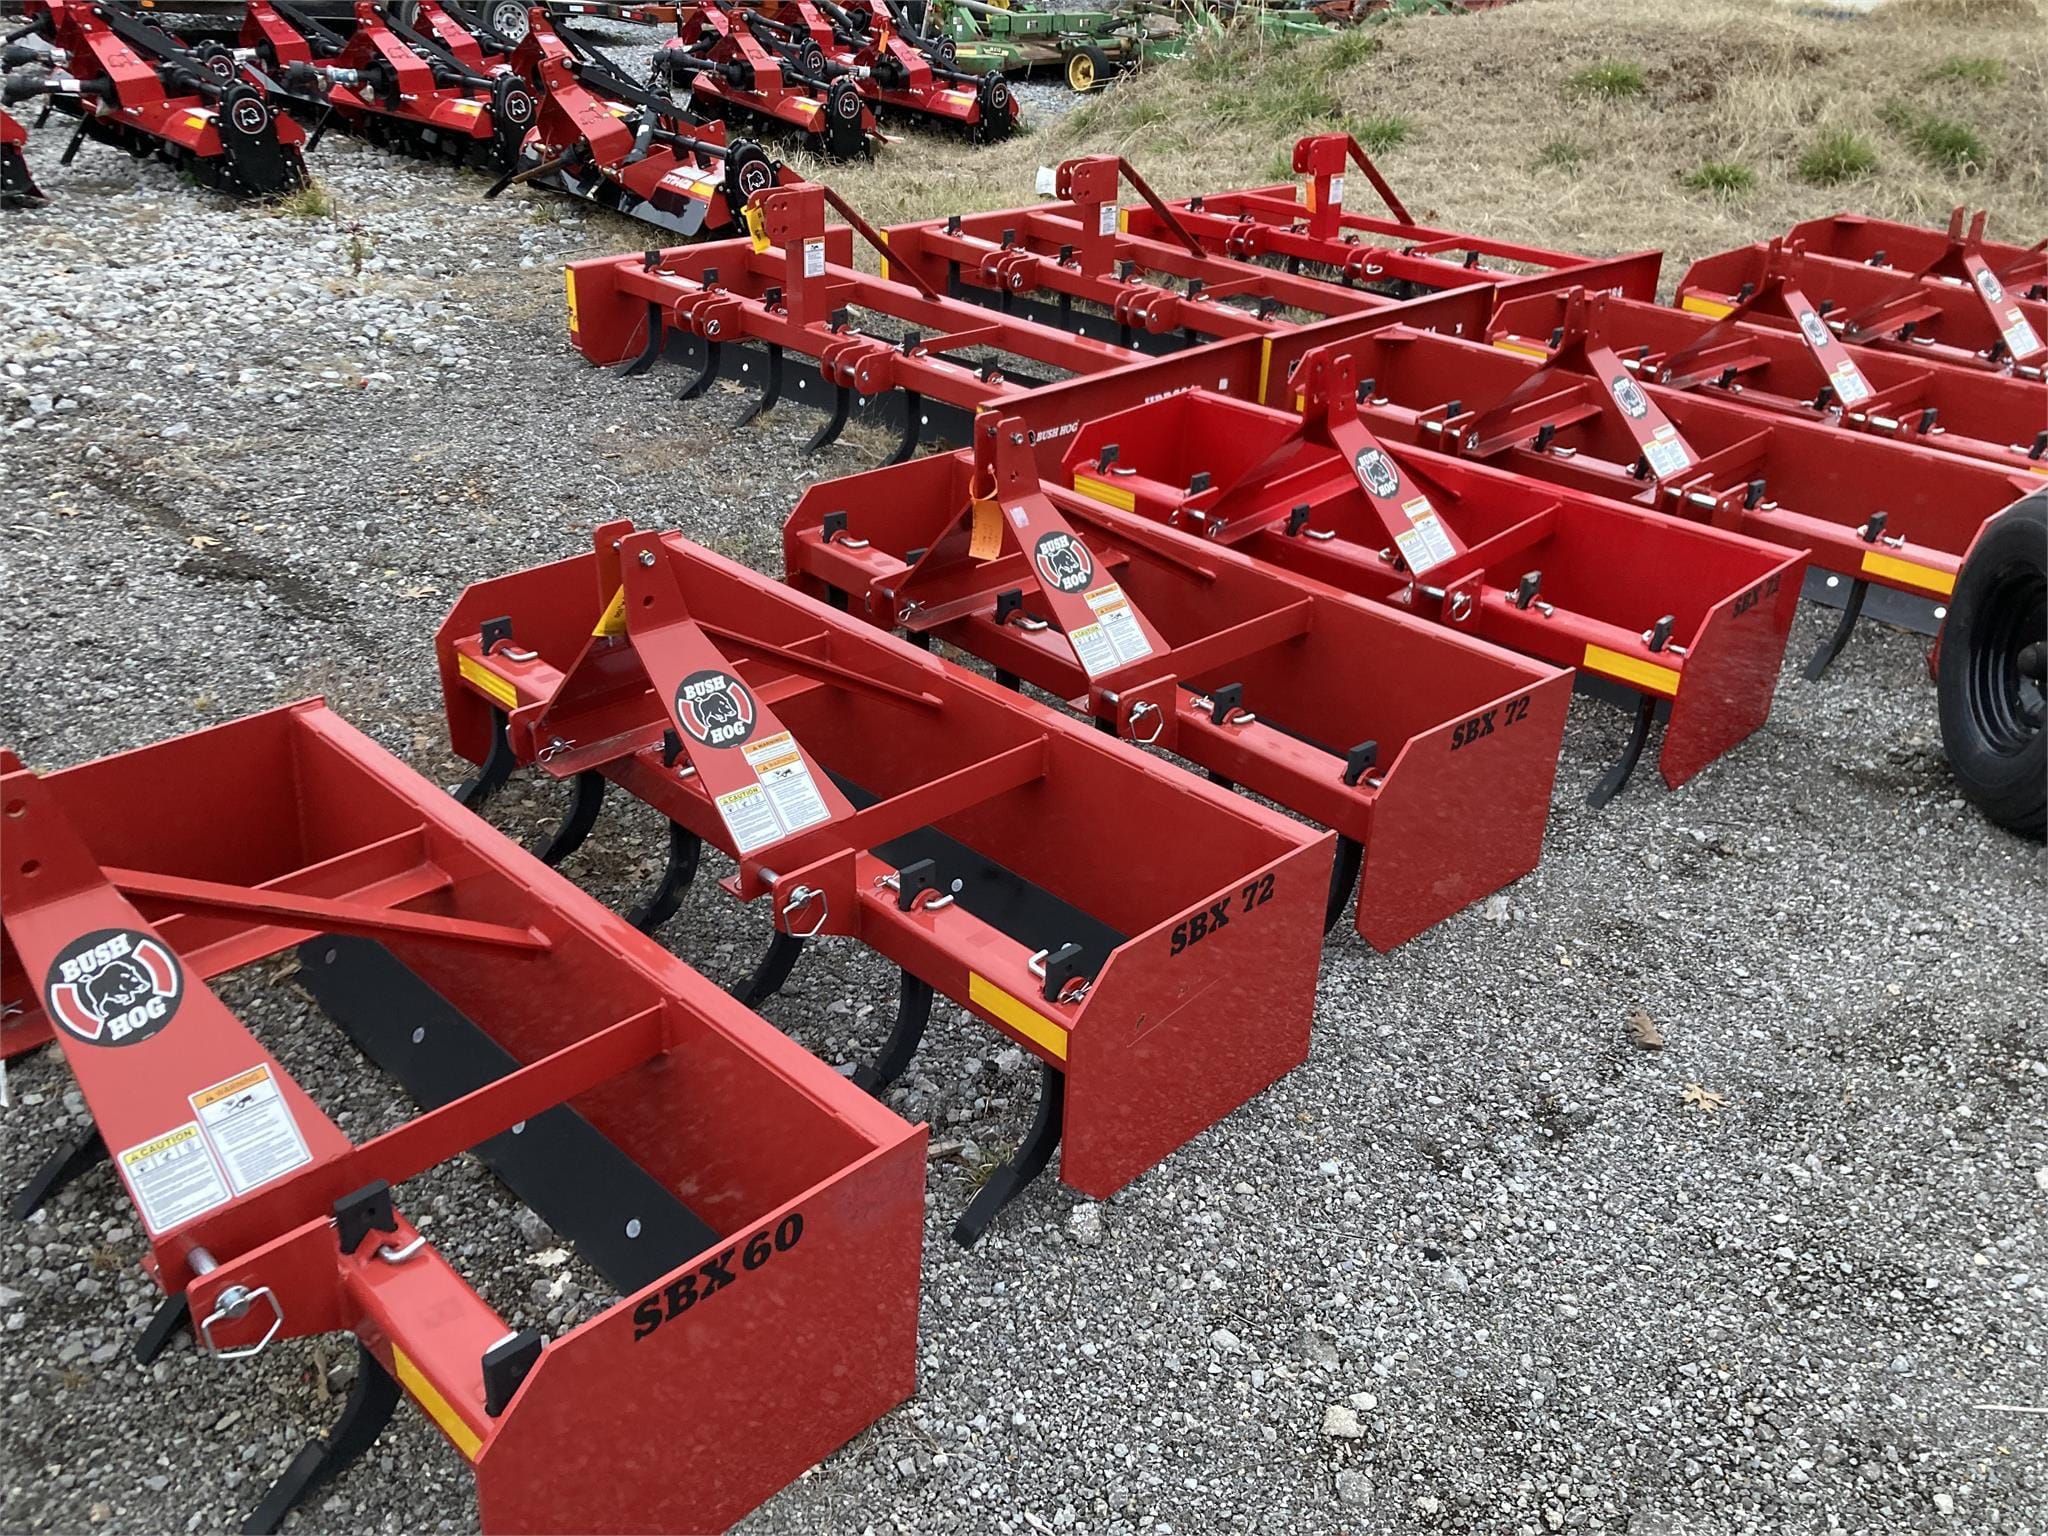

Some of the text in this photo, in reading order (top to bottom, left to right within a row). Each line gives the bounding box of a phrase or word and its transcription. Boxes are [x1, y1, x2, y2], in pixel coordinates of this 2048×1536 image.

[1036, 422, 1079, 442] BUSH HOG
[1039, 535, 1070, 555] BUSH
[1062, 571, 1087, 589] HOG
[684, 675, 726, 700] BUSH
[710, 721, 746, 744] HOG
[1450, 695, 1530, 750] SBX 72
[728, 787, 759, 801] CAUTION
[1170, 873, 1275, 958] SBX 72
[59, 933, 132, 983] BUSH
[107, 995, 167, 1041] HOG
[215, 1074, 260, 1096] WARNING
[140, 1129, 193, 1157] CAUTION
